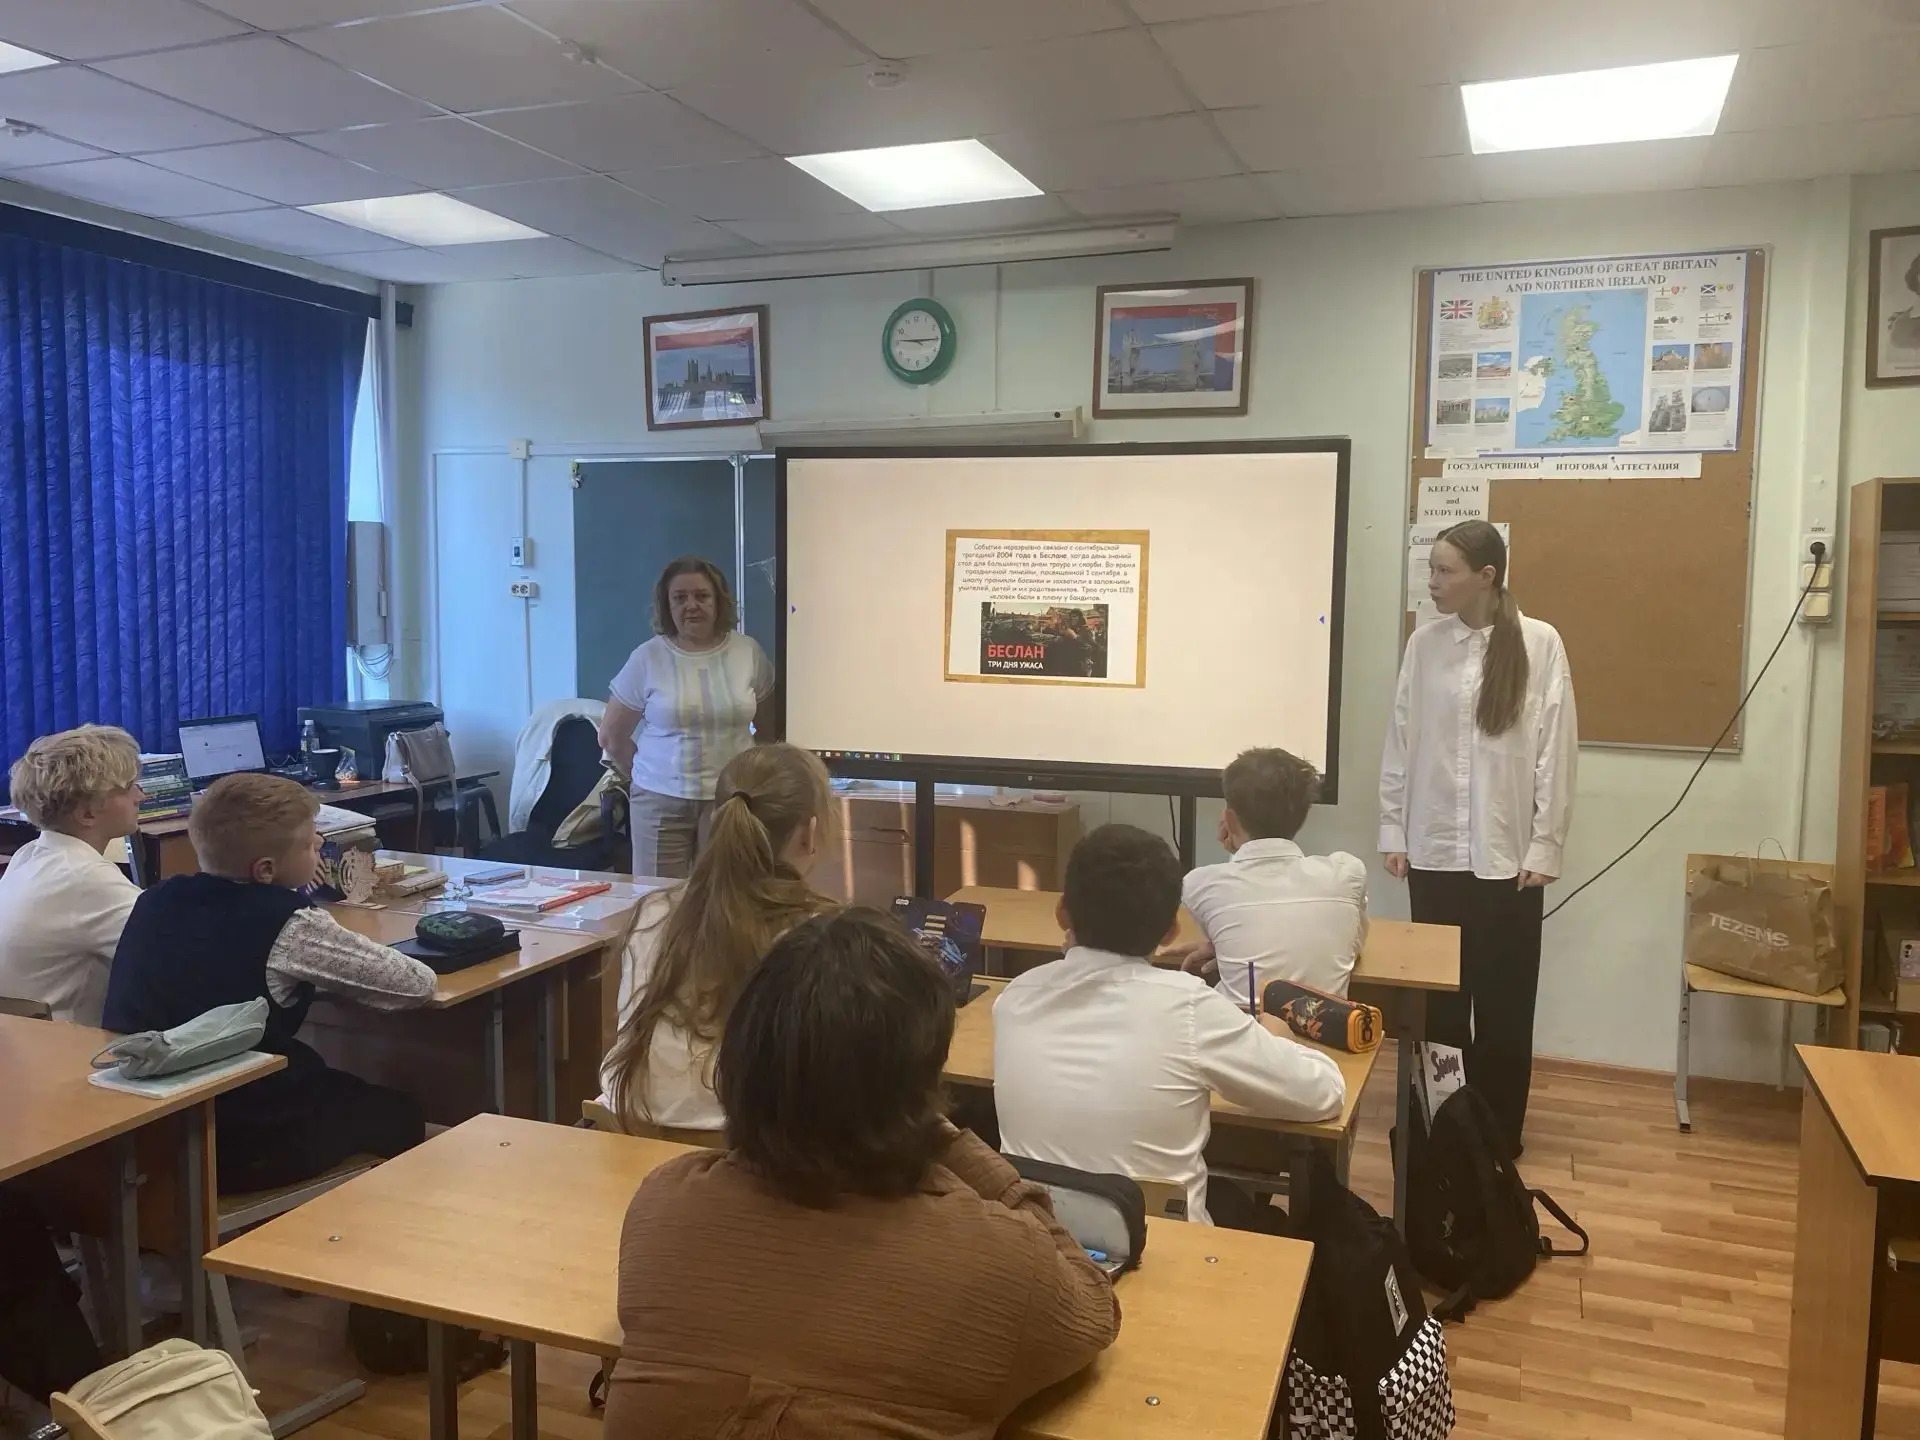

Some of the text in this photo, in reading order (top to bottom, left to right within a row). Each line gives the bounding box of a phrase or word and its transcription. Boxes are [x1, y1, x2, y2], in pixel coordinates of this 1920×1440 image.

[1459, 258, 1718, 282] THE UNITED KINGDOM OF GREAT BRITAIN
[1506, 275, 1666, 293] AND NORTHERN IRELAND
[1448, 462, 1680, 471] ГОСУДАРСТВЕННАЯ ИТОГОВАЯ АТТЕСТАЦИЯ
[988, 644, 1044, 658] БЕСЛАН
[988, 660, 1002, 668] ТРИ
[1002, 661, 1018, 669] ДНЯ
